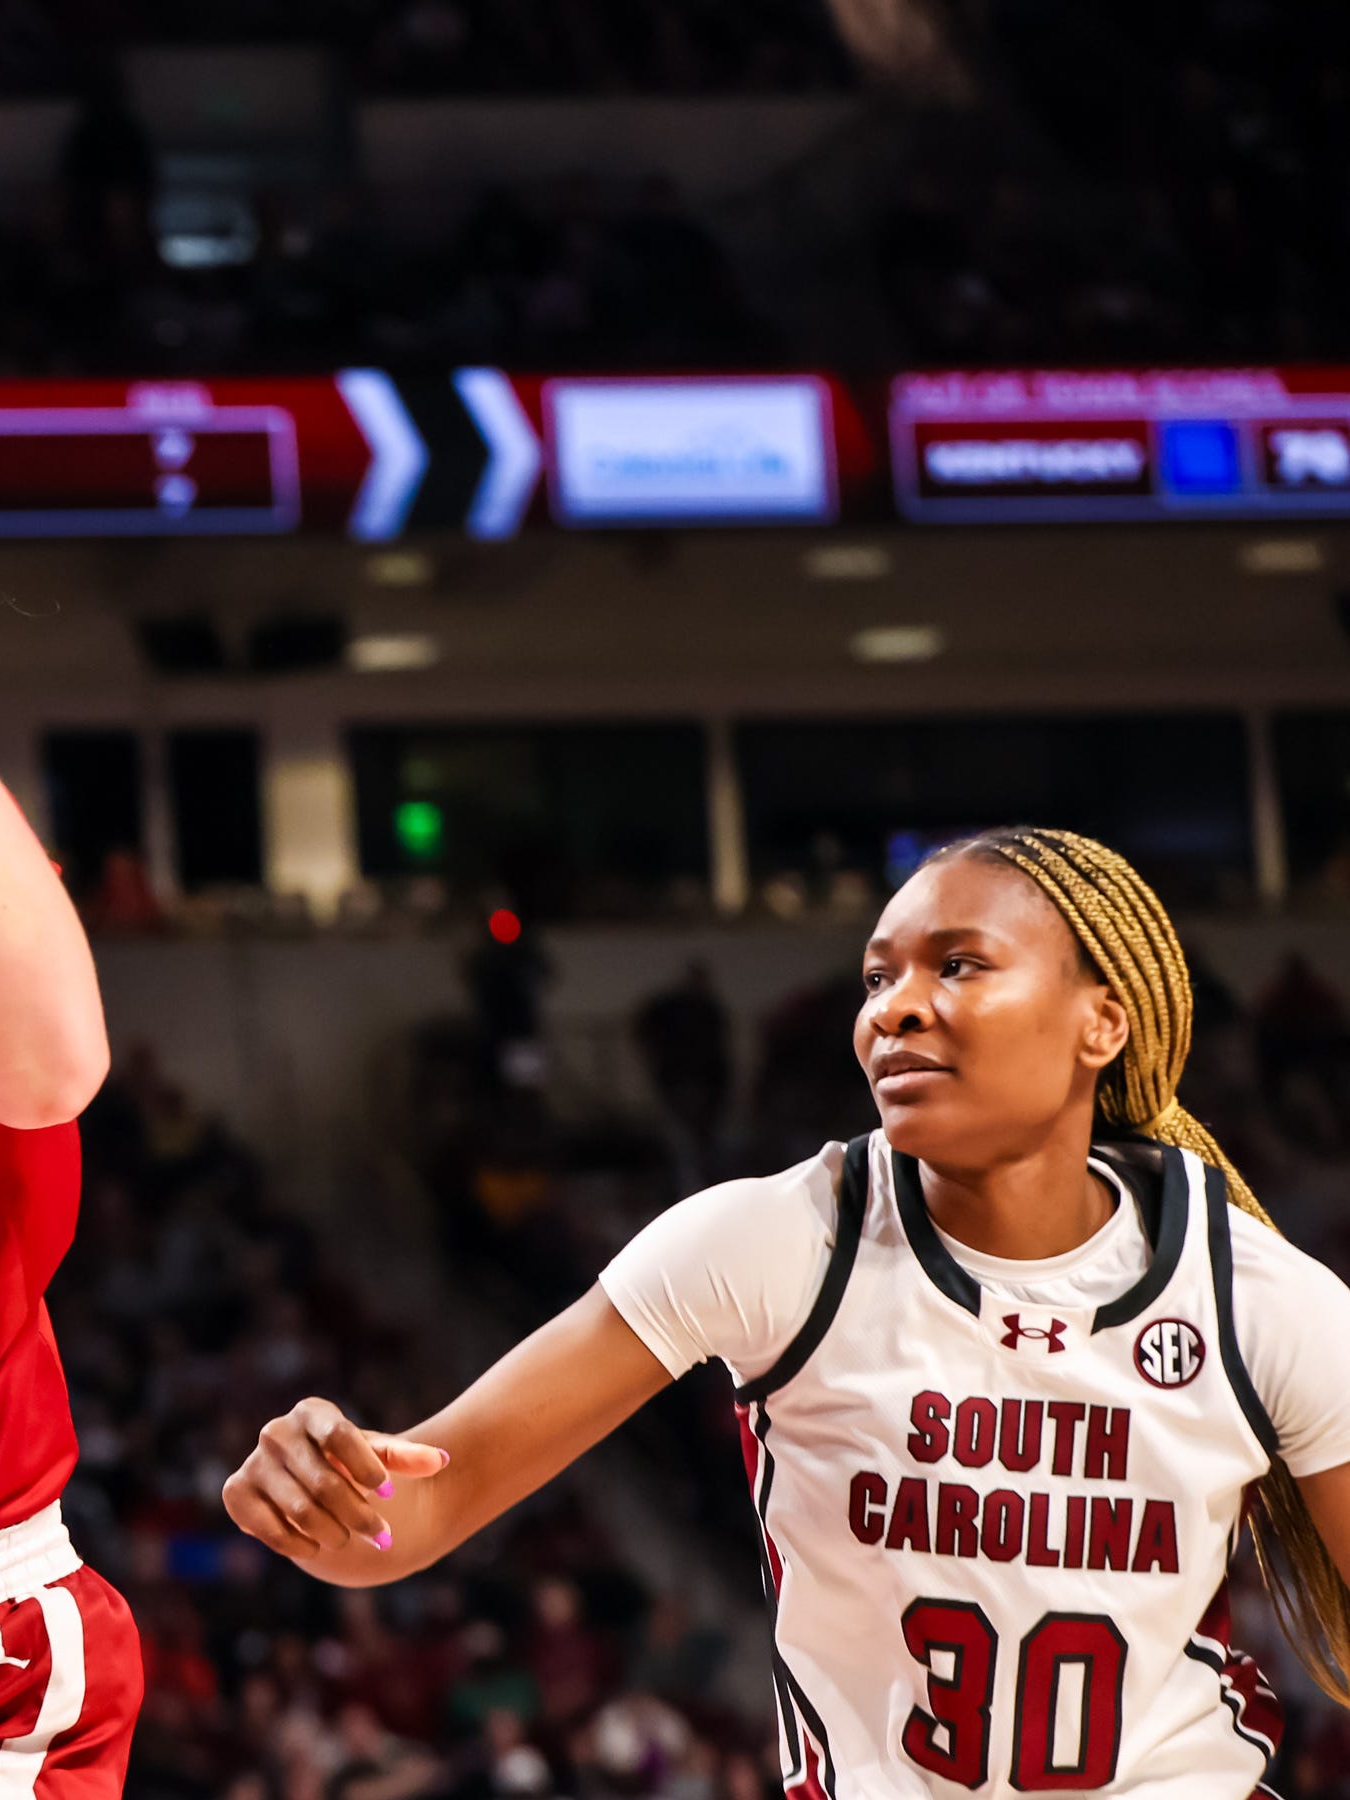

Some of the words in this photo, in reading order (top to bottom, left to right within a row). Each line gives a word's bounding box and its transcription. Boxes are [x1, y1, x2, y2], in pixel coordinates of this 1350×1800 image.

[1139, 1321, 1201, 1384] SEC
[907, 1390, 1131, 1481] SOUTH
[849, 1470, 1180, 1574] CAROLINA
[900, 1596, 1129, 1792] 30
